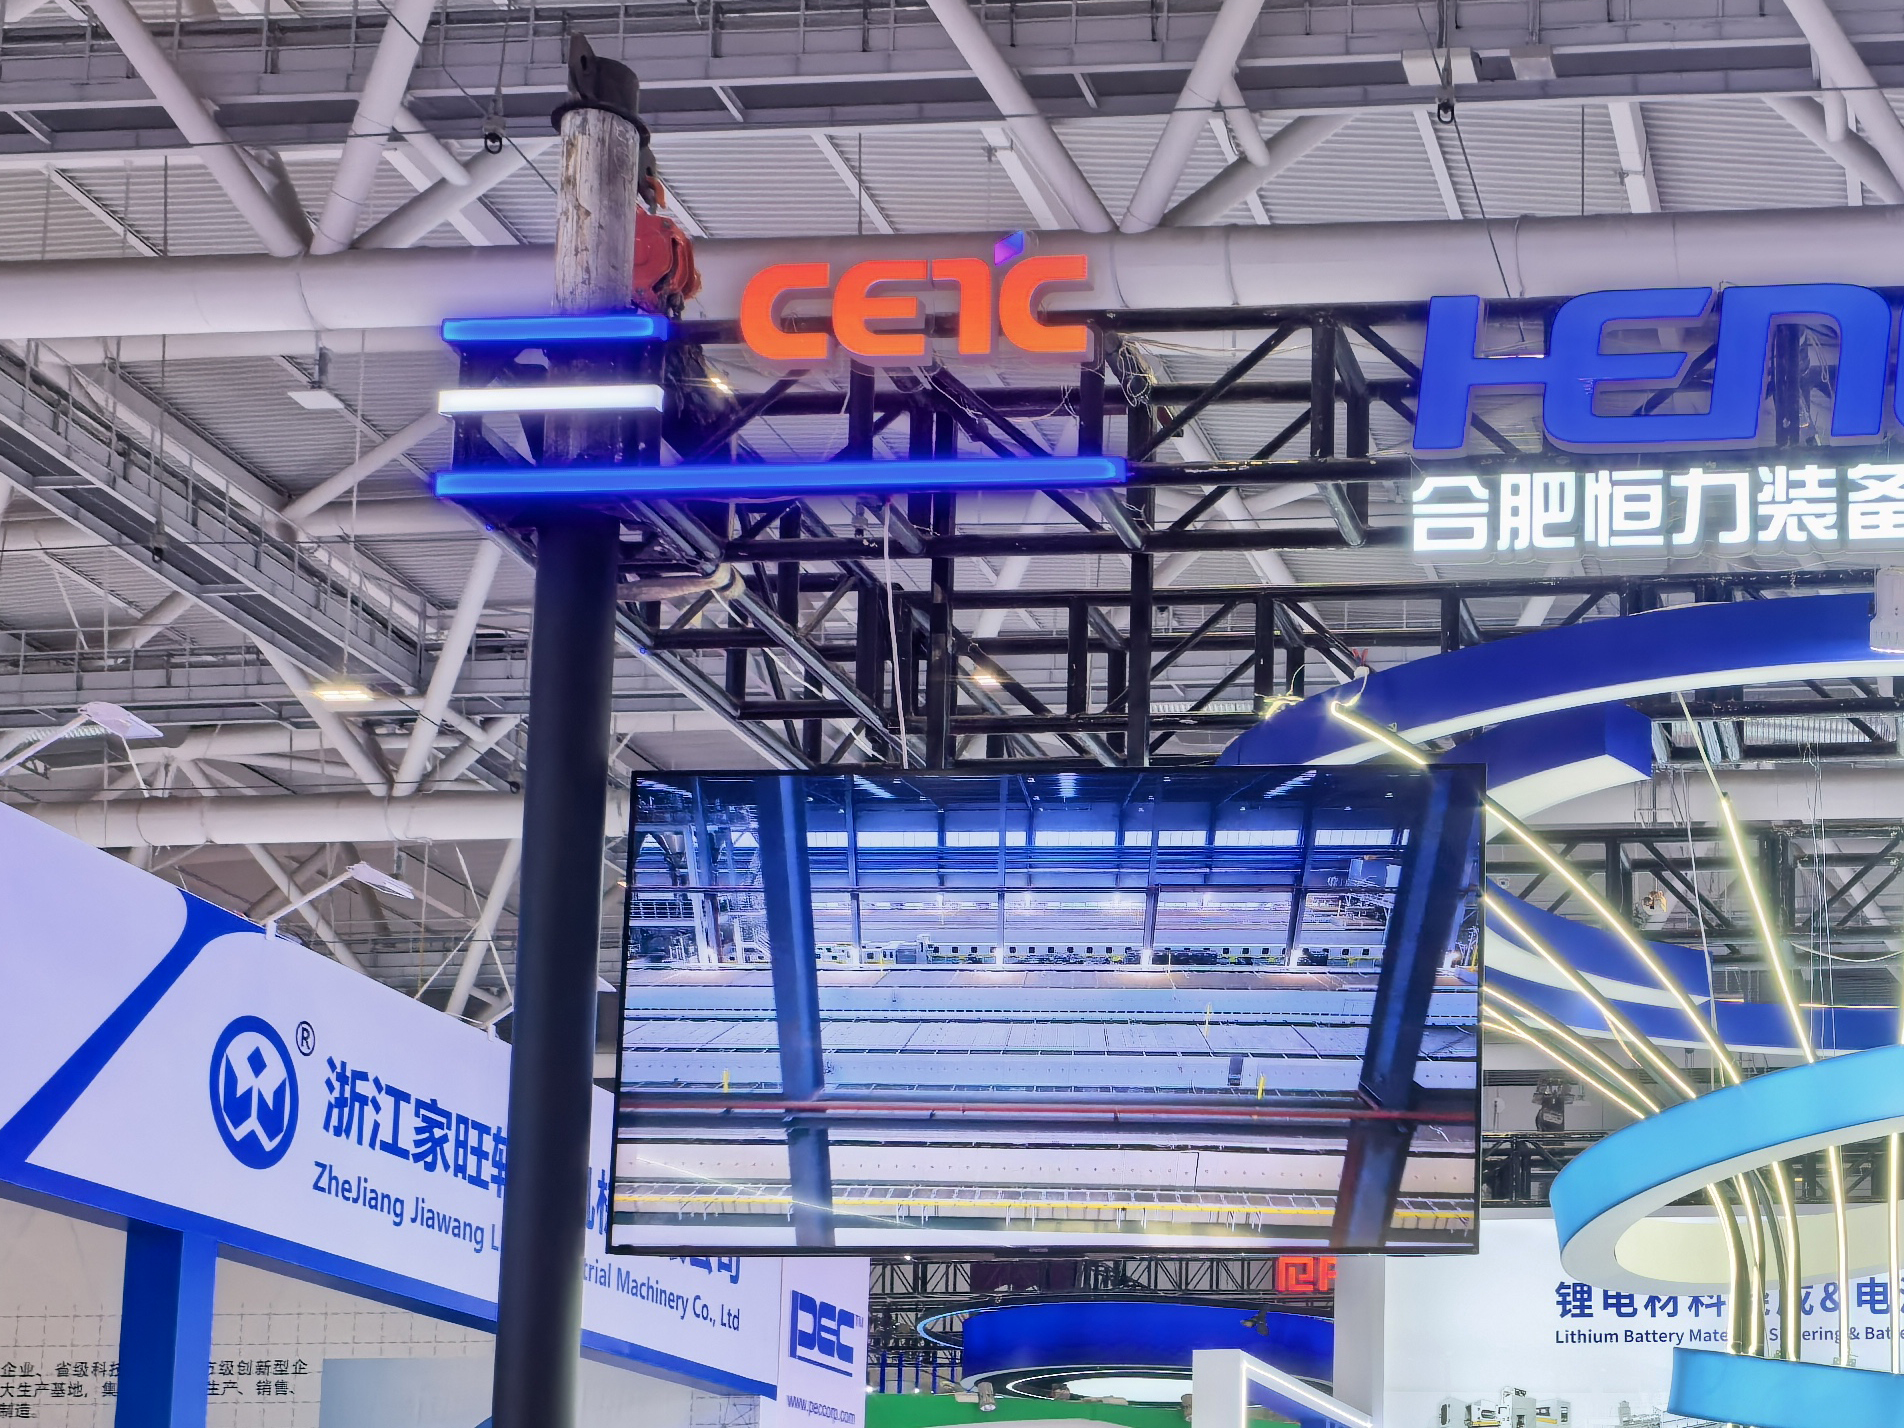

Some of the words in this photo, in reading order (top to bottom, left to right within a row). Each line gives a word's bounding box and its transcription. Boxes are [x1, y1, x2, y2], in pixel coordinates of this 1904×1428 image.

[738, 231, 1088, 362] CETC
[312, 1160, 405, 1227] ZheJiang
[409, 1196, 485, 1254] Jiawang
[616, 1266, 689, 1320] Machinery
[720, 1303, 741, 1332] Ltd
[1555, 1329, 1619, 1345] Lithium
[1624, 1328, 1685, 1347] Battery
